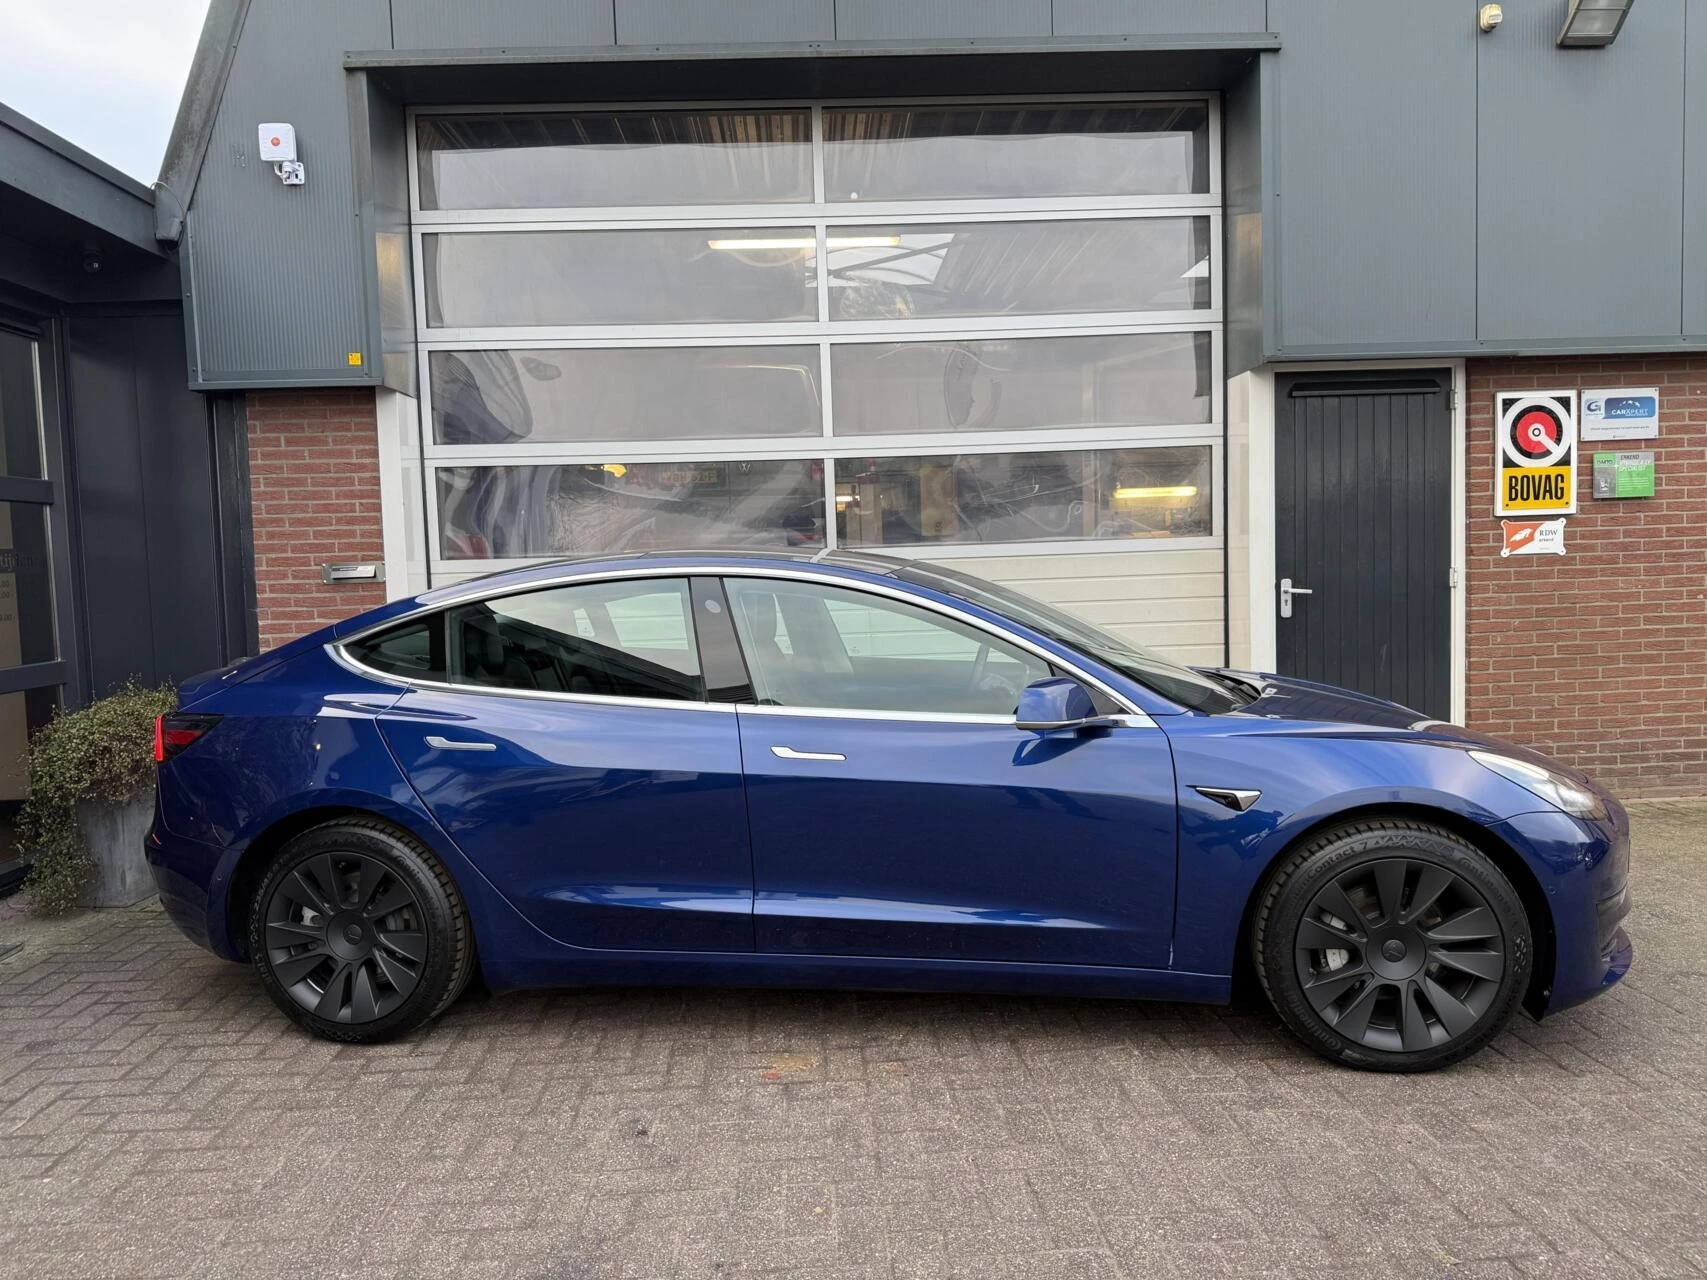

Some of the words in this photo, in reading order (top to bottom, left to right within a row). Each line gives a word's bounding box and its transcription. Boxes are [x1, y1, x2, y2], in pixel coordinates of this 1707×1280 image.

[1611, 408, 1648, 416] CARXPERT
[1508, 474, 1565, 502] BOVAG
[1539, 529, 1558, 537] RDW
